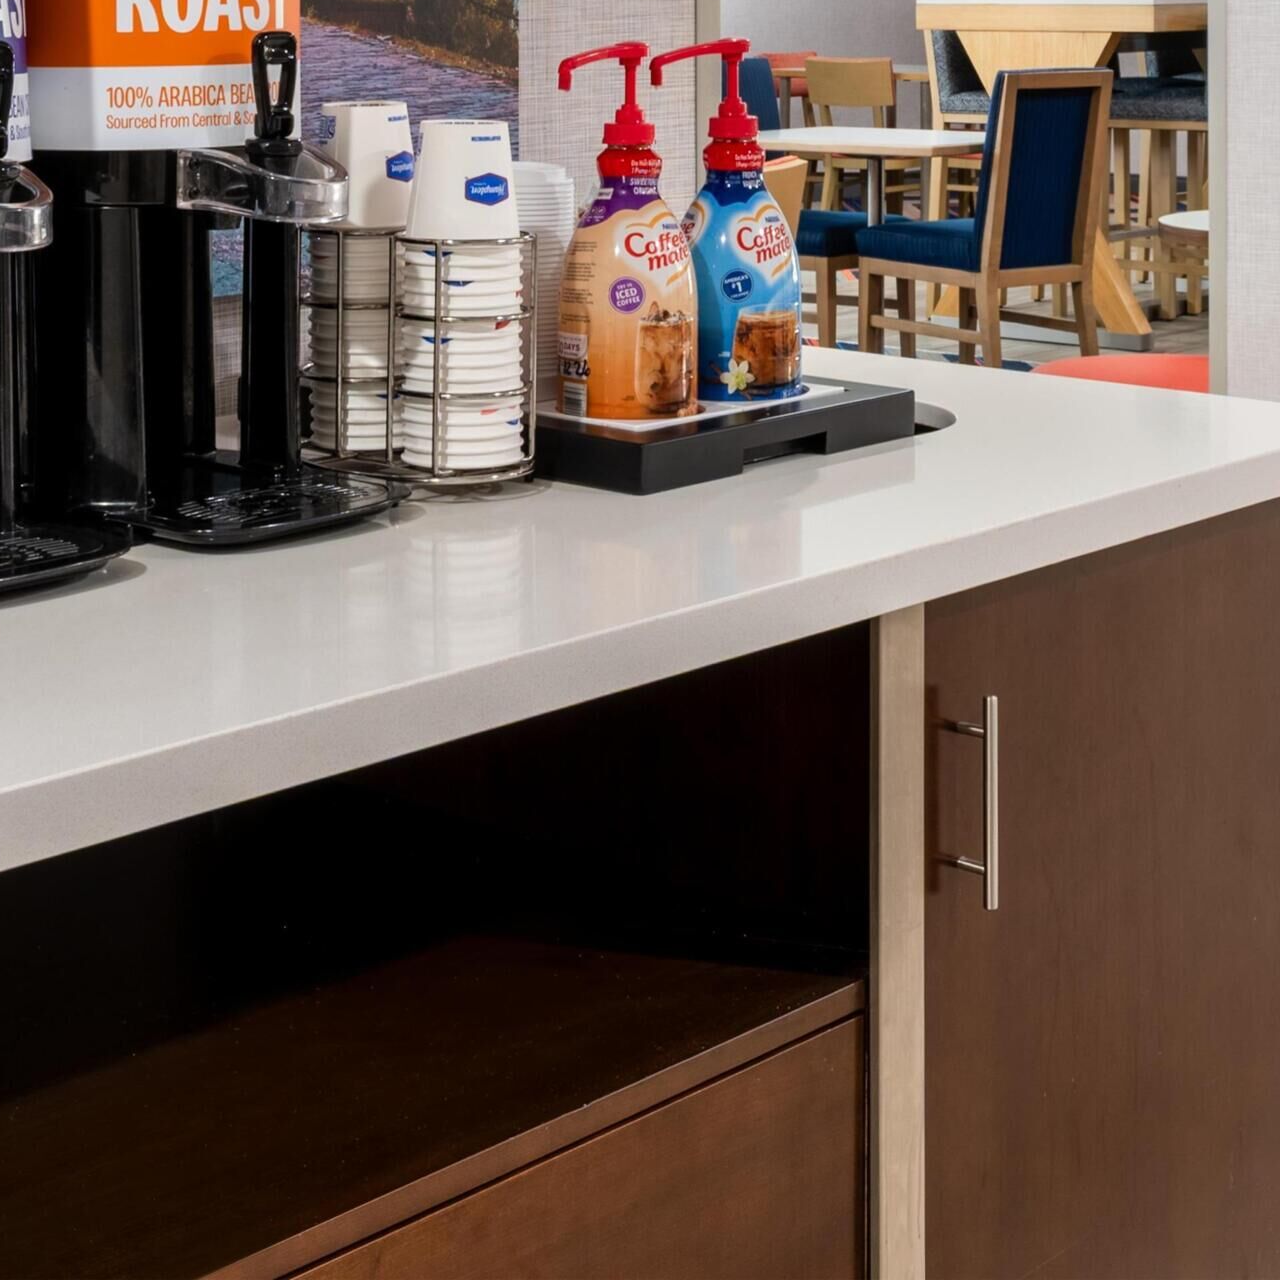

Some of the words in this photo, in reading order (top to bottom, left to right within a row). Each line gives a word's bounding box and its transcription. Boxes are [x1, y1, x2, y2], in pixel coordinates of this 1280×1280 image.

[106, 87, 153, 108] 100%
[158, 84, 226, 107] ARABICA
[231, 83, 255, 104] BEA
[106, 115, 157, 129] Sourced
[160, 113, 190, 128] From
[192, 111, 231, 127] Central
[234, 112, 241, 125] &
[624, 231, 685, 257] Coffee
[737, 223, 786, 251] Coffee
[756, 236, 791, 263] mate
[648, 244, 689, 271] mate
[615, 287, 637, 300] ICED
[616, 296, 641, 307] COFFEE
